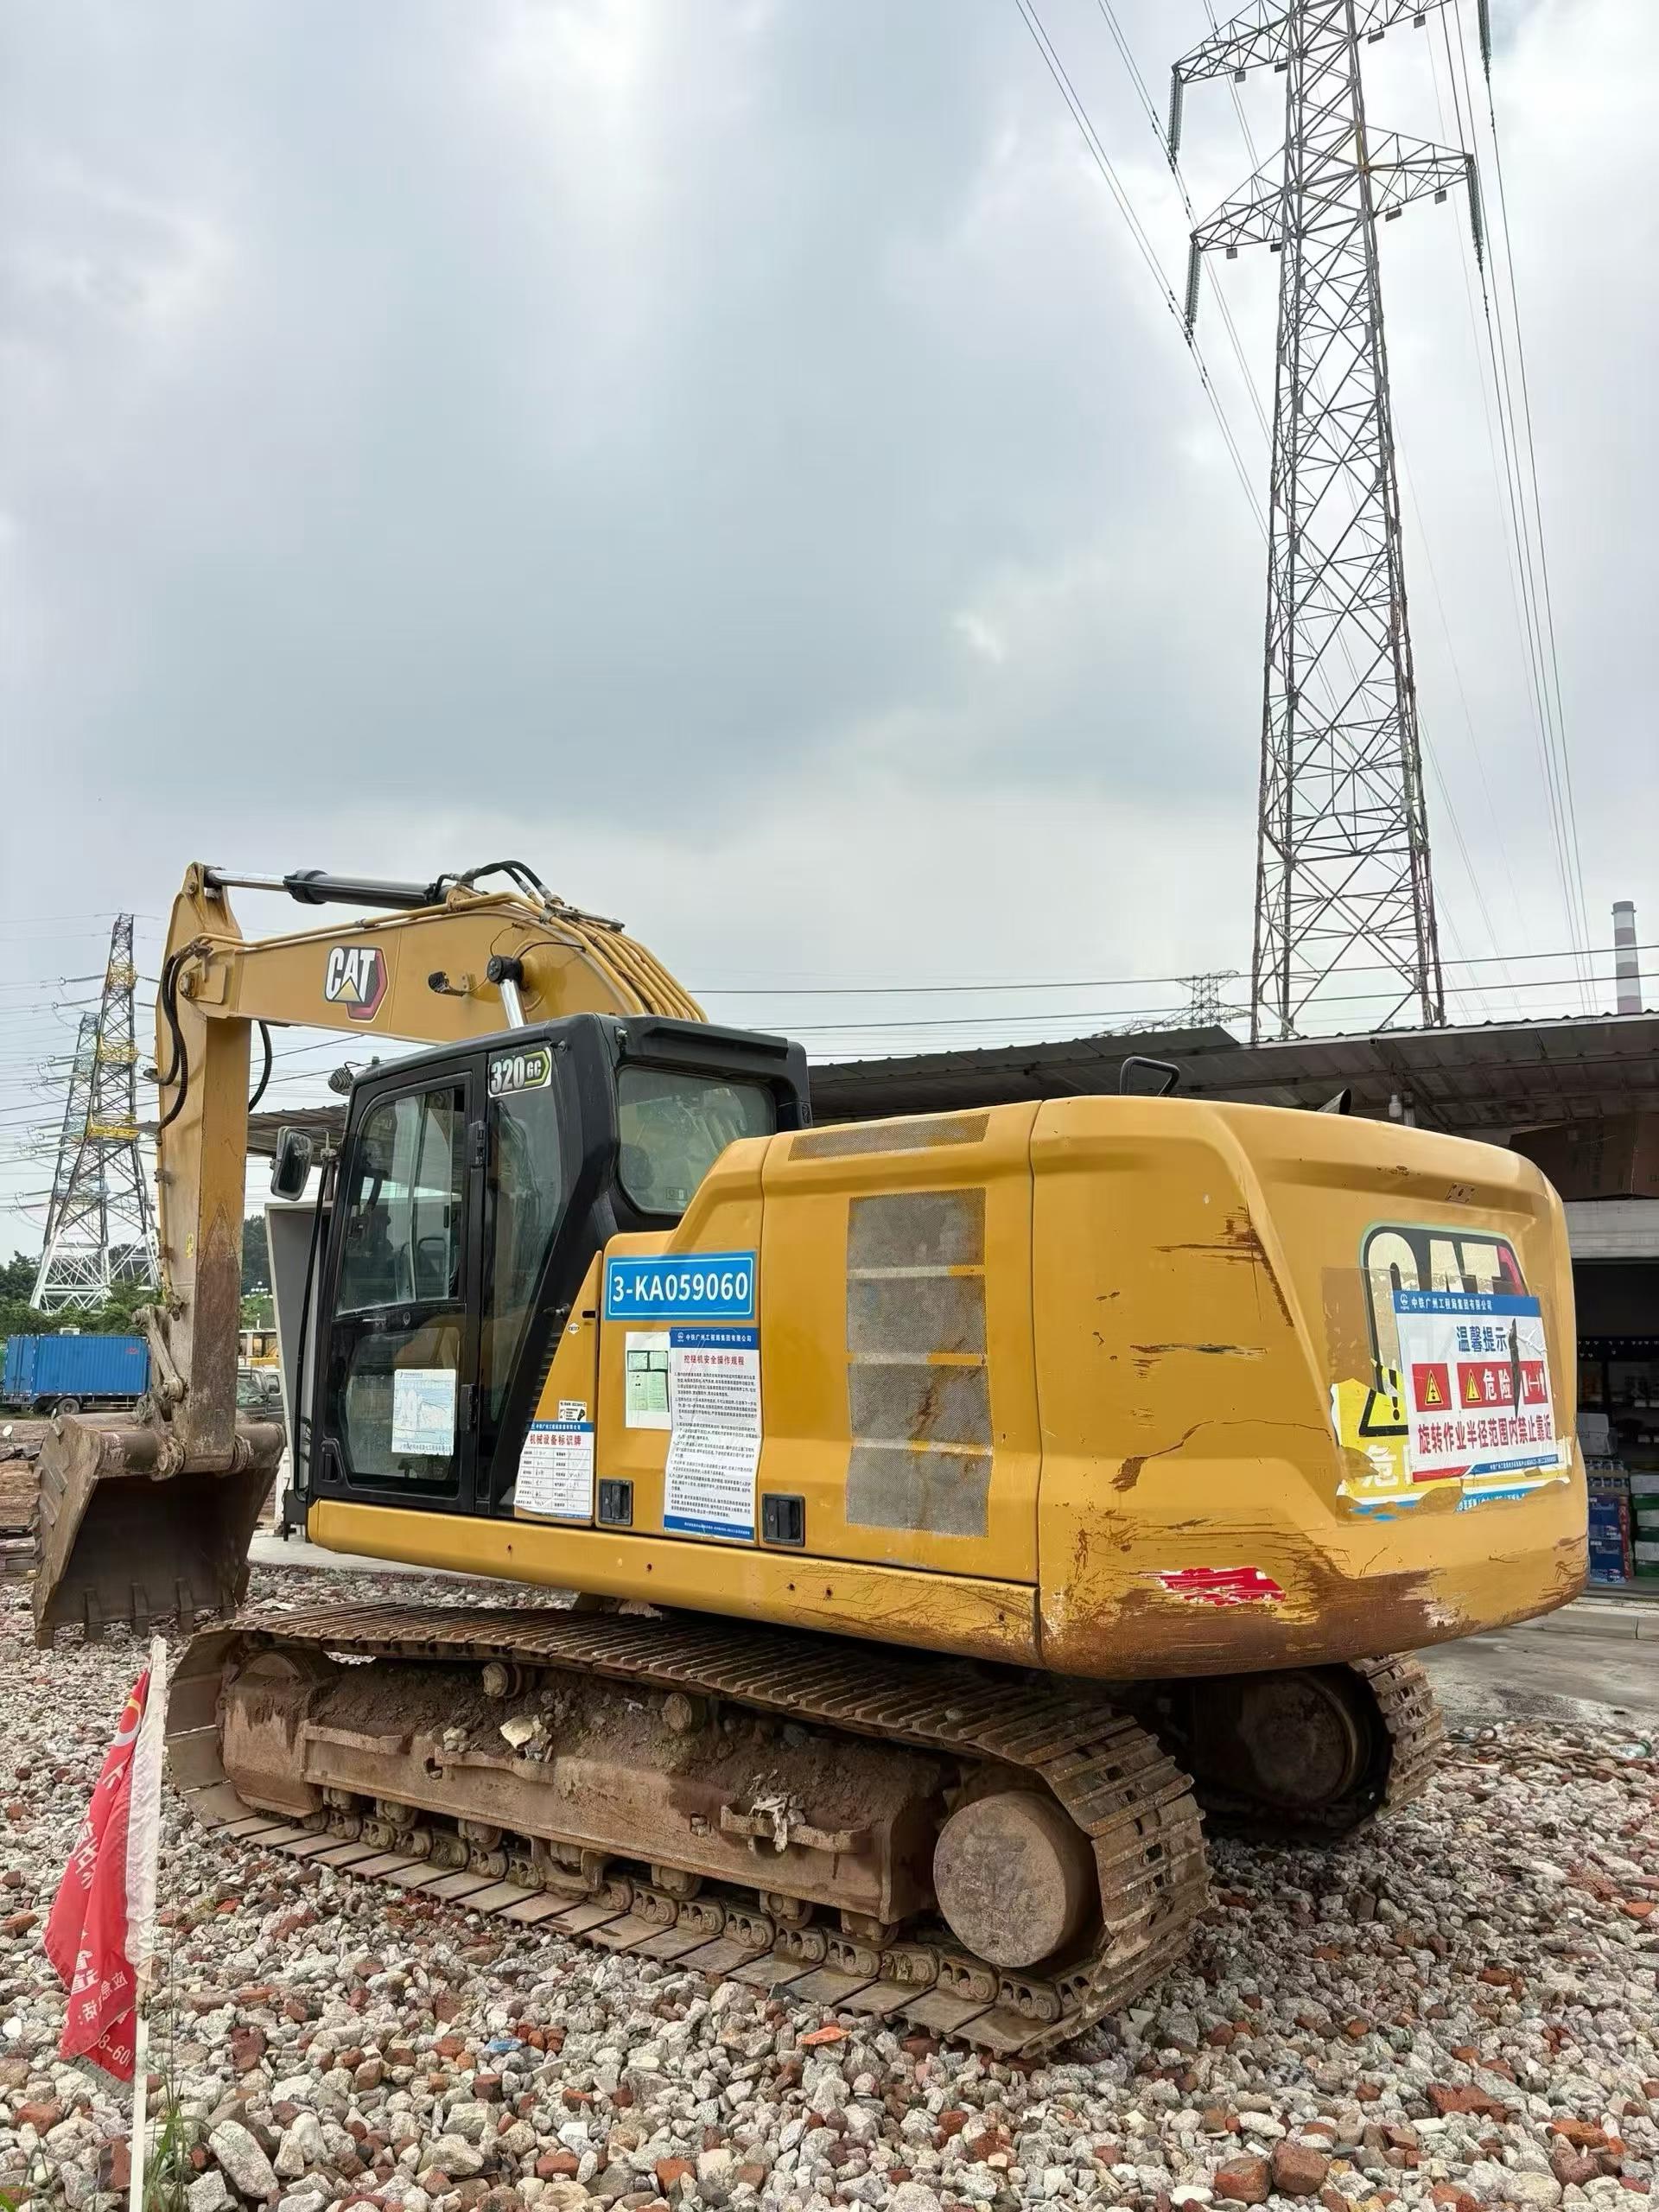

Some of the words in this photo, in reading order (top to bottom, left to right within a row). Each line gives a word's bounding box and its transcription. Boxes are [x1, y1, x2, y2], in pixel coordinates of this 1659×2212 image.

[326, 947, 376, 1002] CAT
[491, 1056, 524, 1094] 320
[526, 1058, 542, 1078] GC
[612, 1272, 748, 1302] 3-KA059060
[1411, 1297, 1492, 1311] 中铁广州工程局集团有限公司
[1456, 1325, 1508, 1352] 温馨提示
[683, 1354, 745, 1366] 挖掘机安全操作规程
[1483, 1368, 1512, 1402] 危险
[530, 1433, 582, 1446] 机械设备标识牌
[1418, 1414, 1553, 1455] 旋转作业半径范围内禁止靠近
